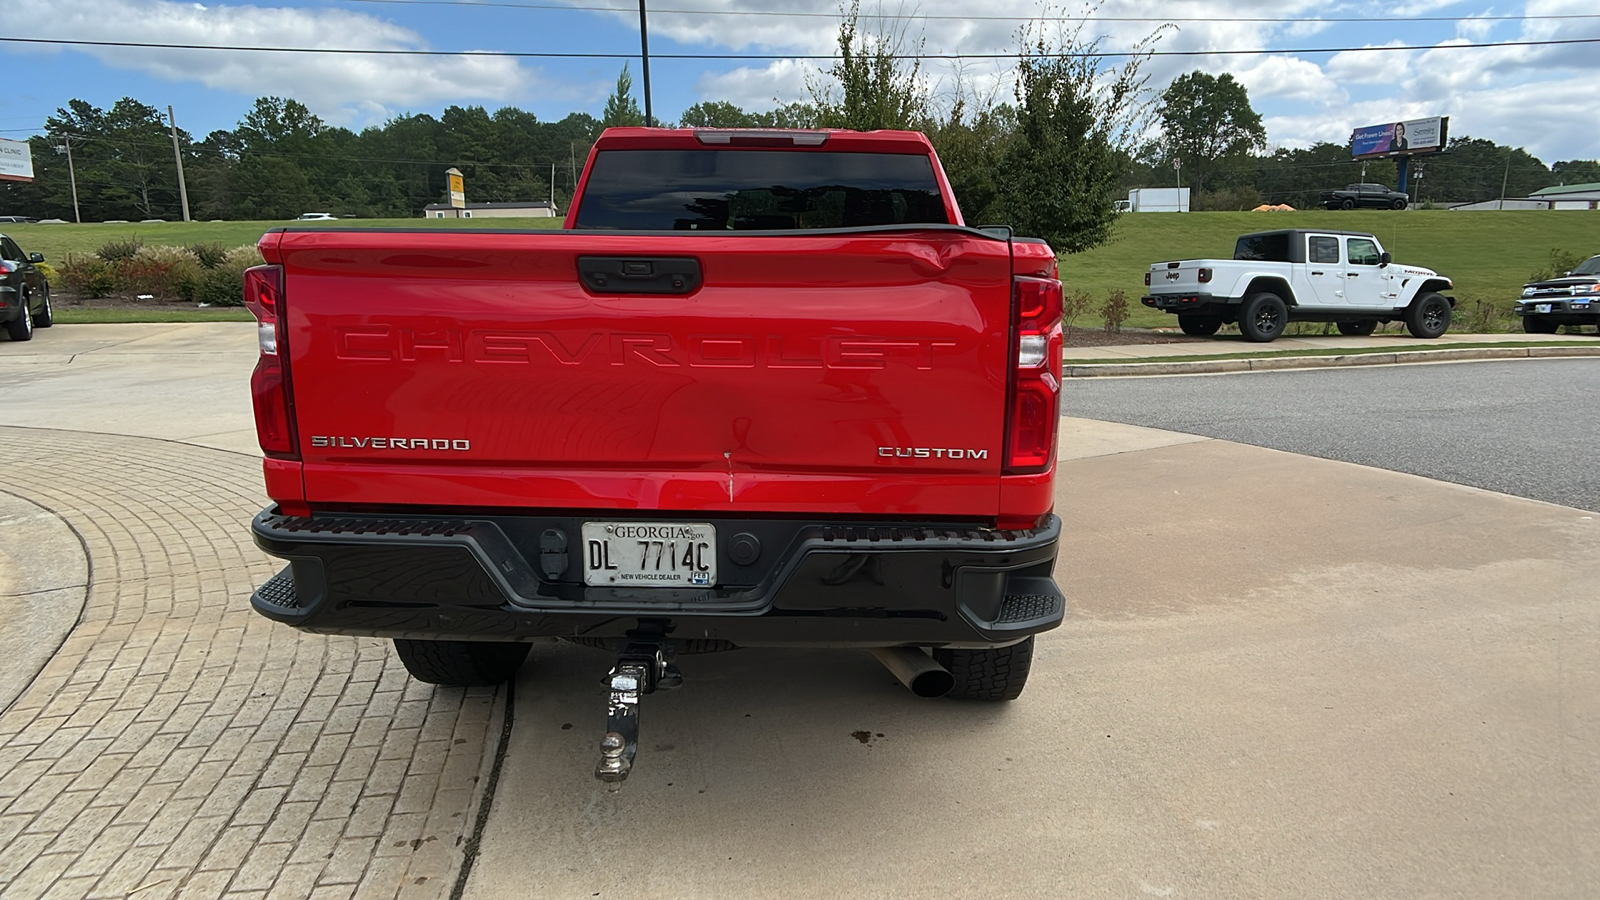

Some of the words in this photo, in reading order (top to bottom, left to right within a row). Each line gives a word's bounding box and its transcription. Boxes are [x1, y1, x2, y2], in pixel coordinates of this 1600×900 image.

[1165, 271, 1180, 280] Jeep
[334, 325, 957, 371] CHEVROLET
[311, 435, 470, 450] SILVERADO
[878, 446, 988, 460] CUSTOM
[588, 540, 618, 570] DL
[637, 540, 709, 571] 7714C
